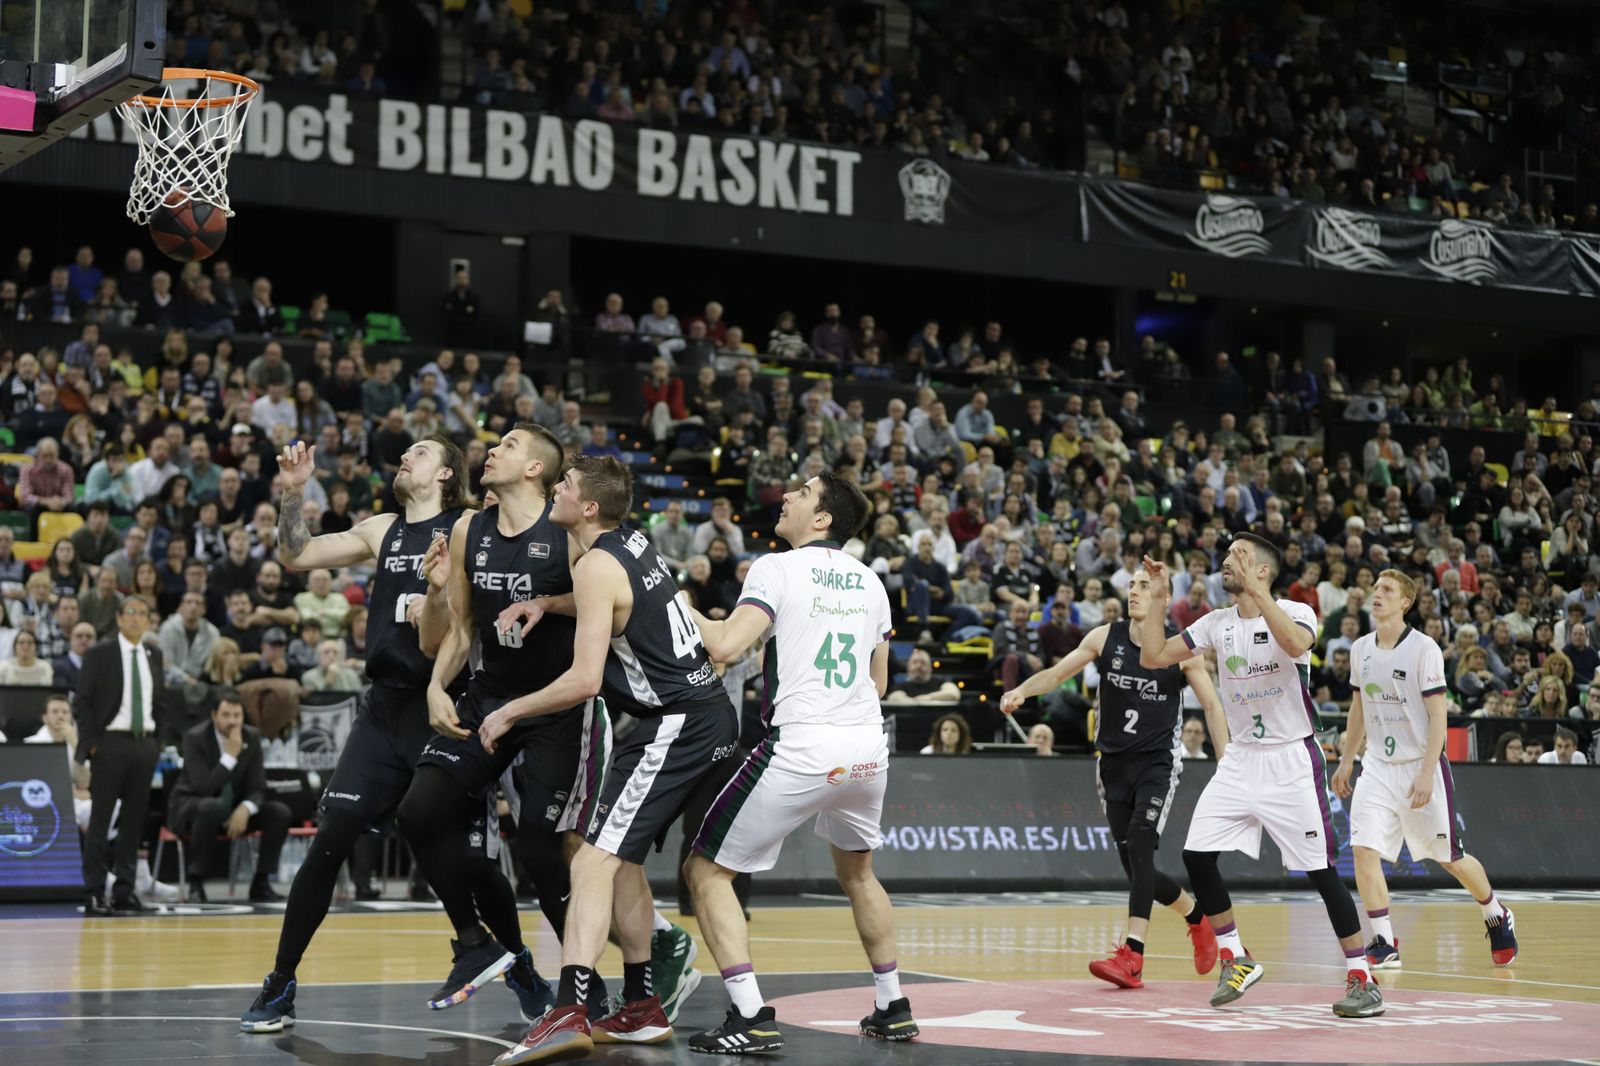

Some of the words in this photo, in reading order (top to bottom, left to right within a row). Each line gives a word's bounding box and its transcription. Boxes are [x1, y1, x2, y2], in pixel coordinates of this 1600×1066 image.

[378, 99, 614, 190] BILBAO
[637, 128, 862, 216] BASKET
[1170, 271, 1186, 288] 21
[385, 554, 425, 577] RET
[473, 571, 532, 599] RETA
[811, 567, 865, 590] SUÁREZ
[666, 590, 704, 659] 44
[813, 631, 857, 689] 43
[1107, 672, 1158, 696] RETA
[1123, 709, 1138, 734] 2
[1252, 714, 1265, 739] 3
[1384, 736, 1395, 757] 9
[852, 762, 878, 771] COSTA
[881, 826, 1113, 851] MOVISTAR.ES/LIT
